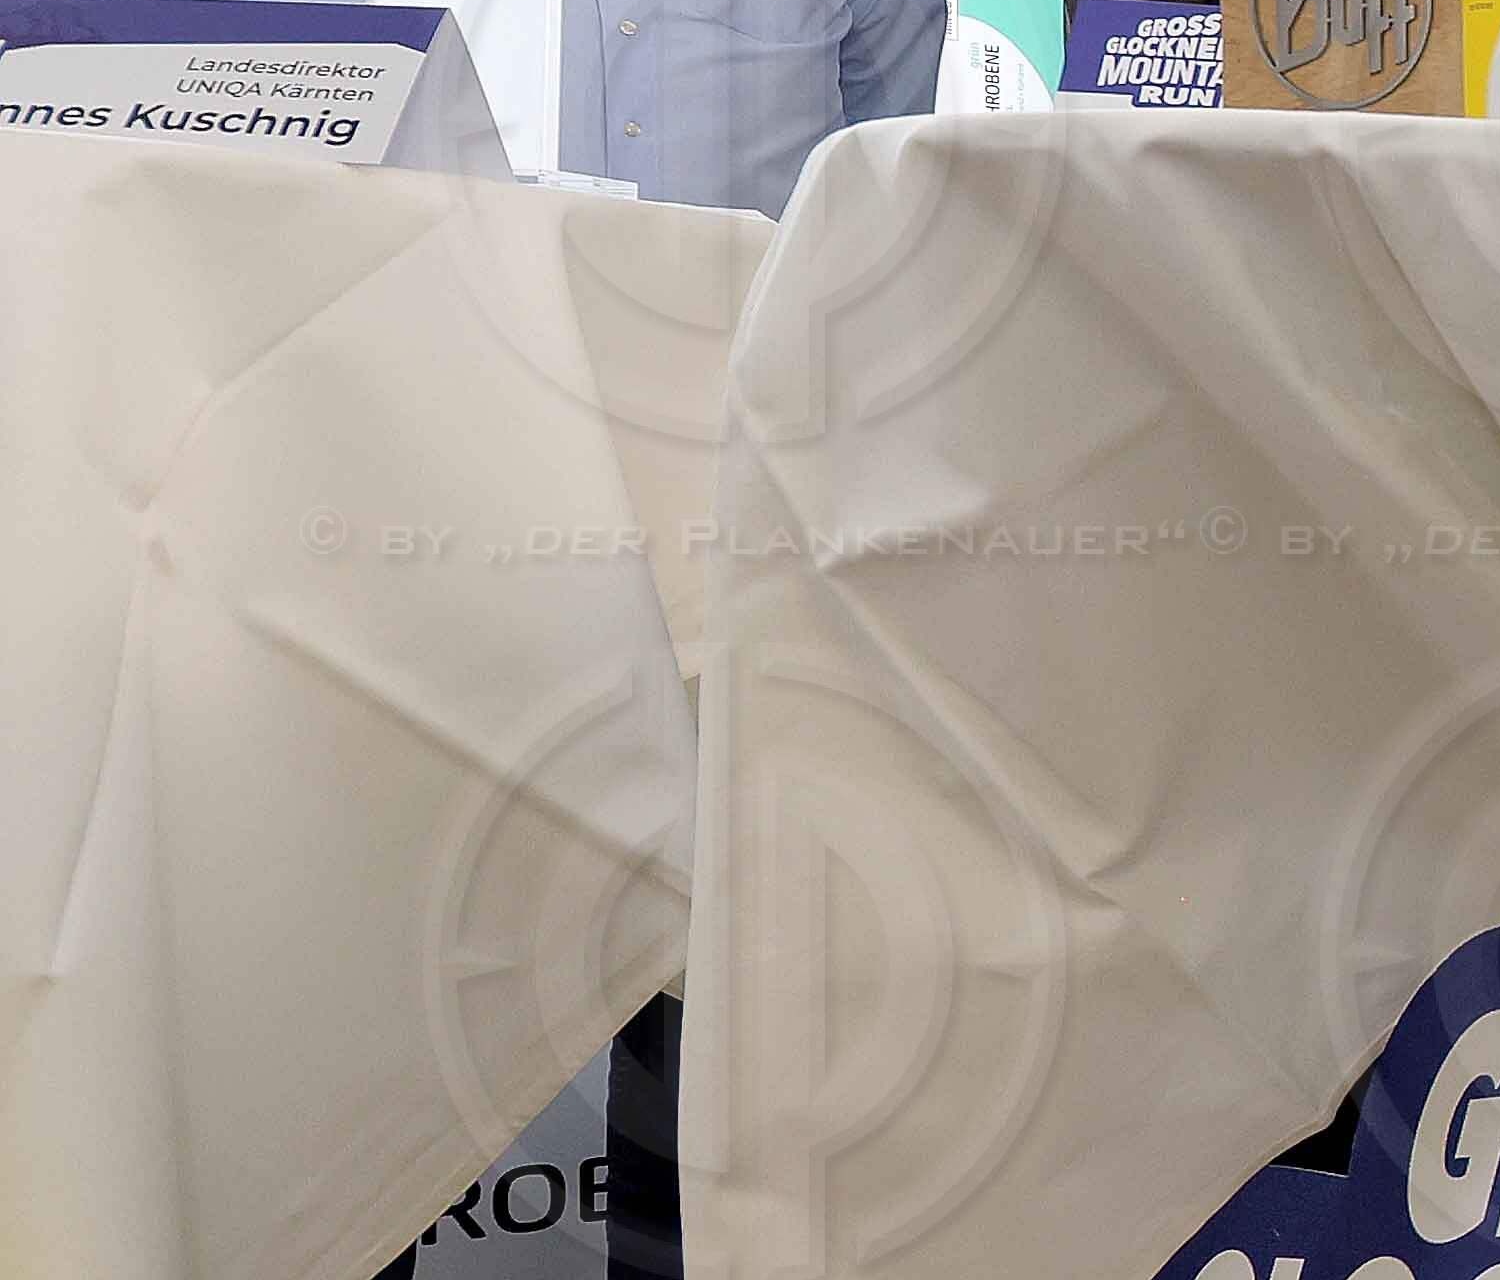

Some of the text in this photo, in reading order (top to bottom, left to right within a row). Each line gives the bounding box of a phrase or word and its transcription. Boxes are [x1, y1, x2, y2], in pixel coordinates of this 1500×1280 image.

[1138, 13, 1223, 37] GROSS
[1105, 36, 1224, 60] GLOCKNE
[185, 57, 387, 80] Landesdirektor
[1097, 55, 1224, 87] MOUNTA
[176, 79, 375, 102] UNIQA Kärnten
[1139, 86, 1216, 106] RUN
[124, 103, 361, 147] Kuschnig
